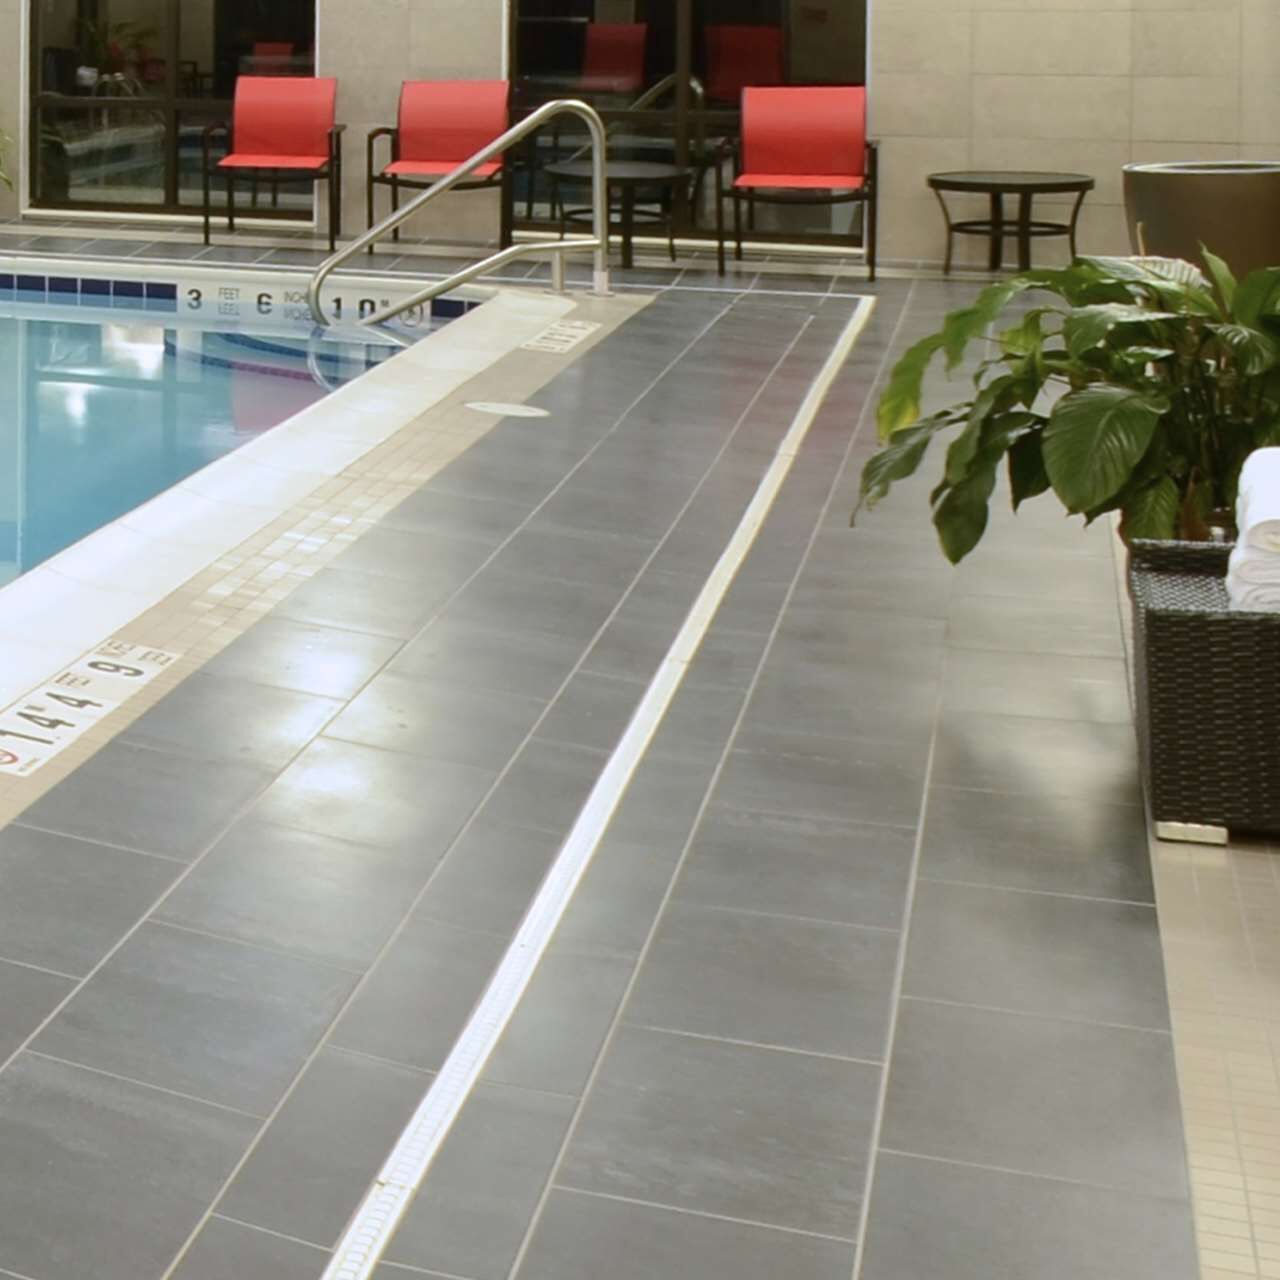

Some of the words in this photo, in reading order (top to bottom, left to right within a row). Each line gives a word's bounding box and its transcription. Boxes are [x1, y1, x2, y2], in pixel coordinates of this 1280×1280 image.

[187, 288, 202, 310] 3
[45, 692, 104, 709] 4
[87, 660, 145, 677] 9
